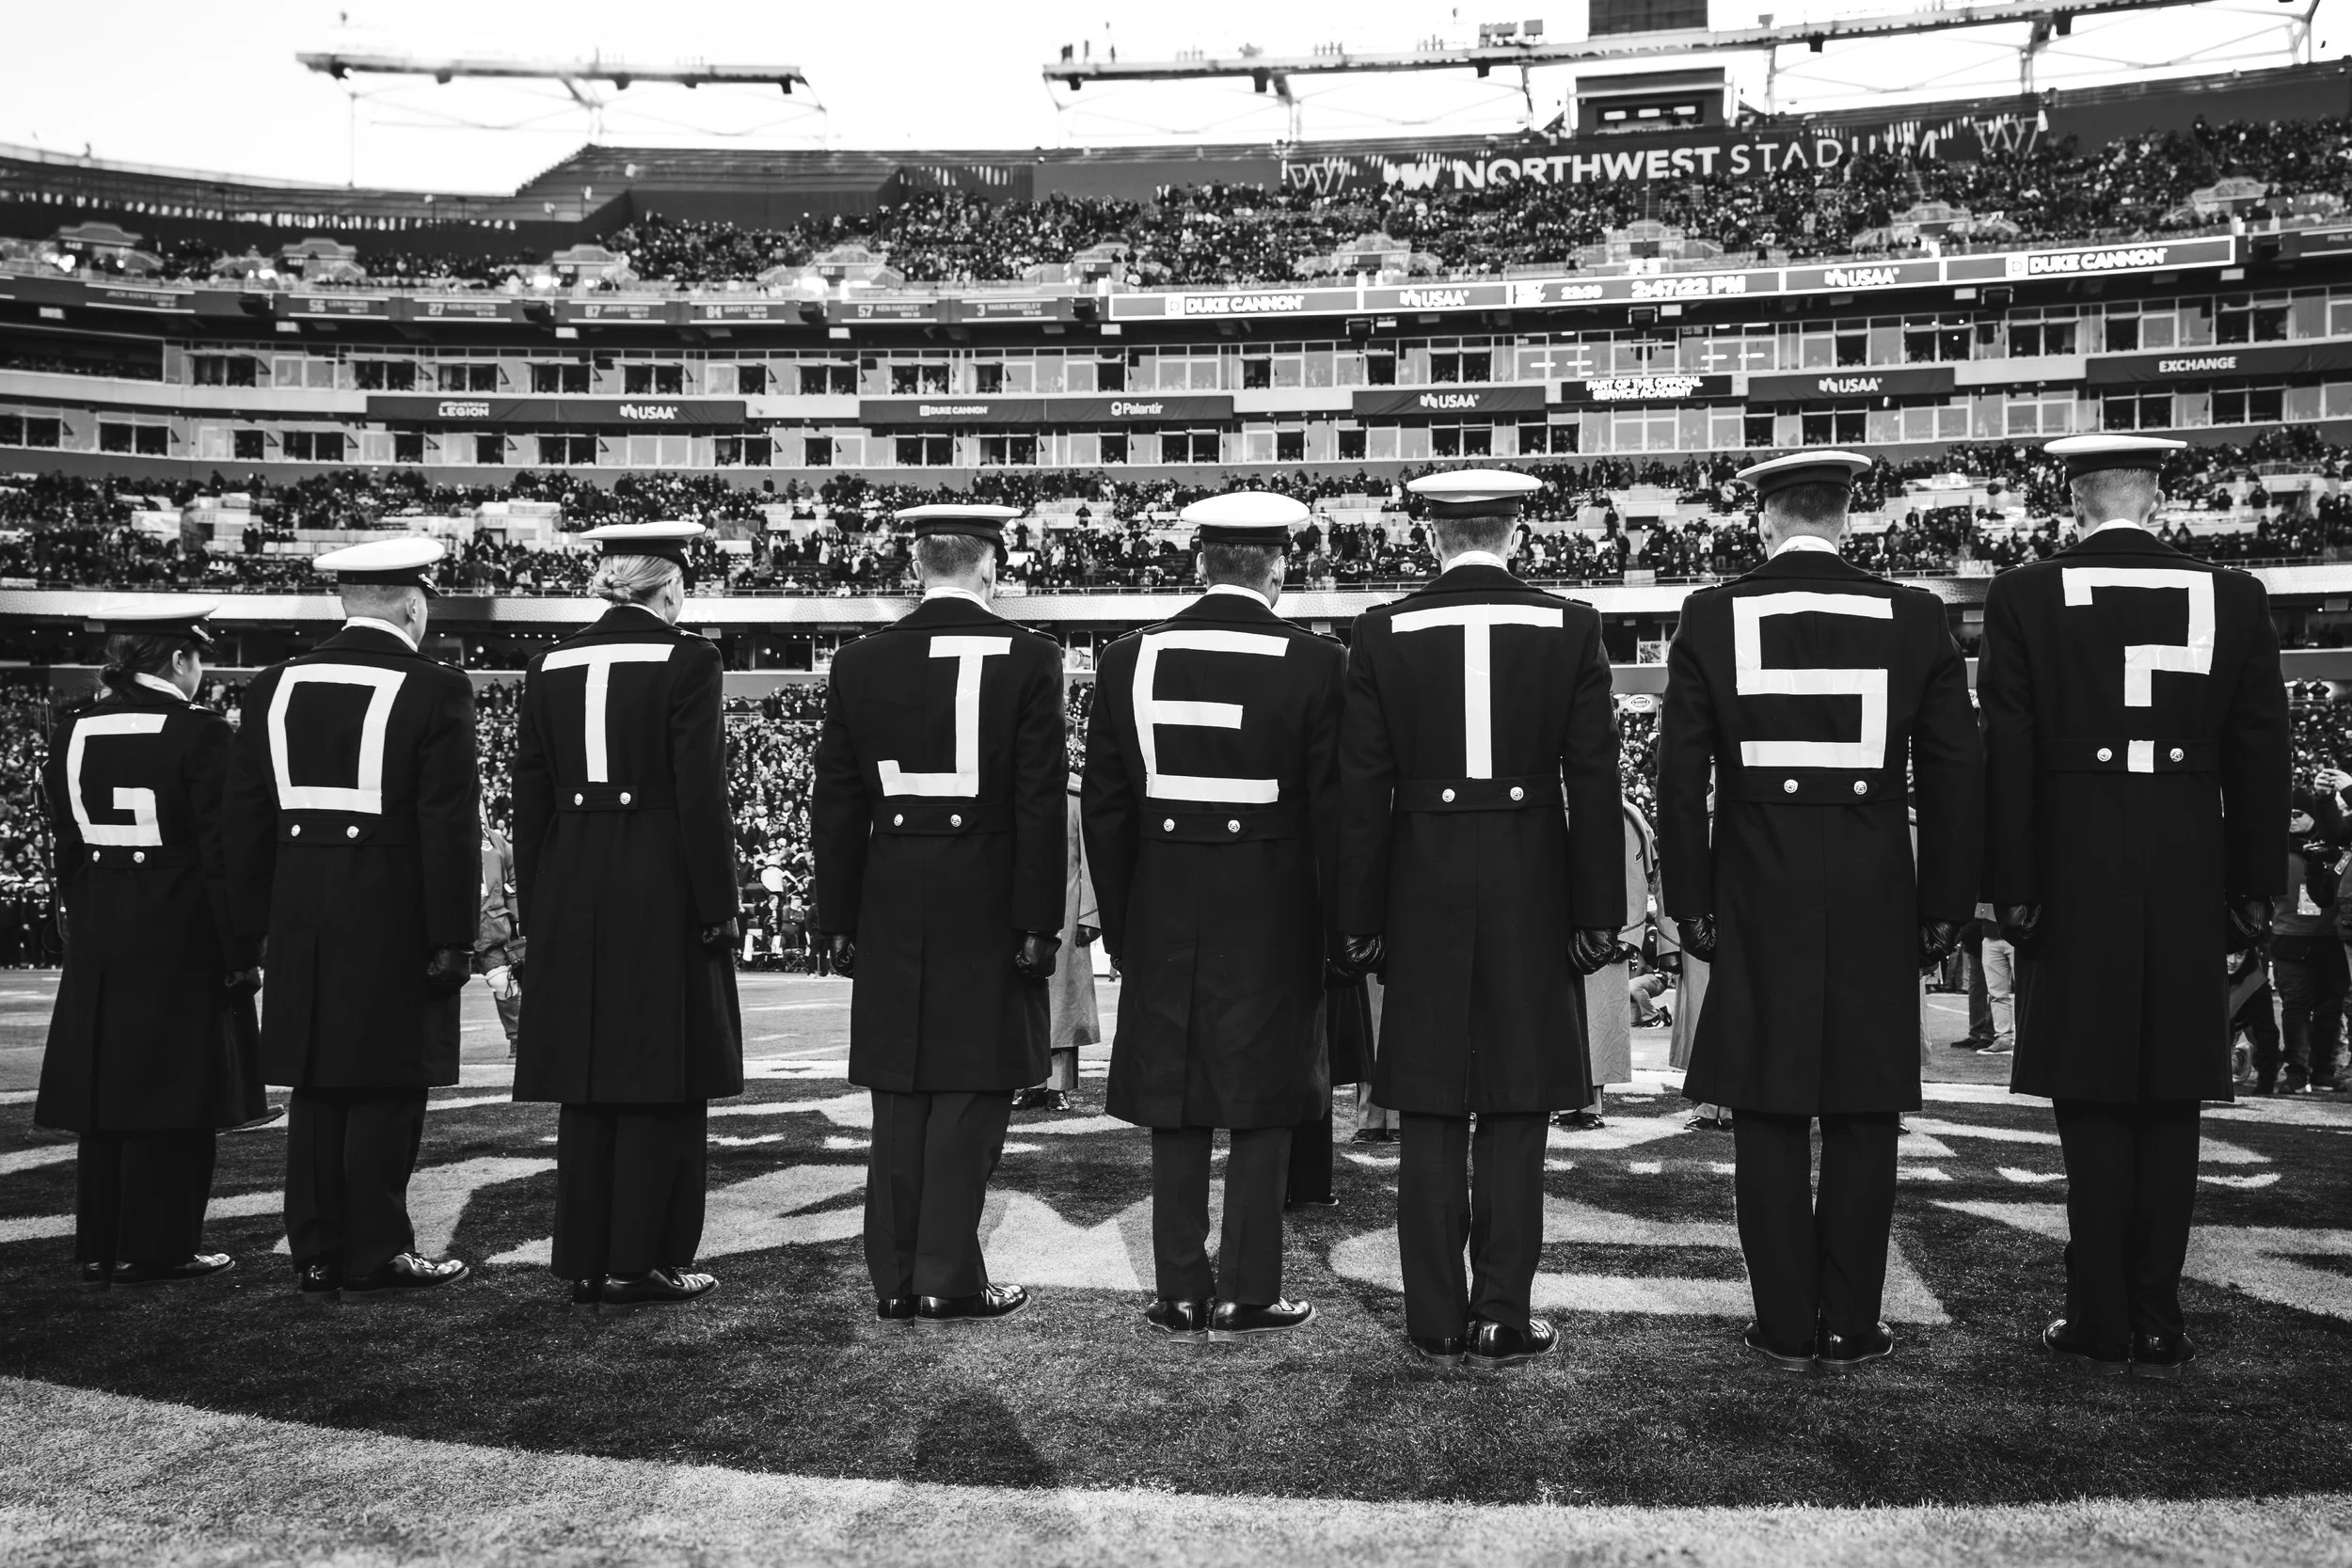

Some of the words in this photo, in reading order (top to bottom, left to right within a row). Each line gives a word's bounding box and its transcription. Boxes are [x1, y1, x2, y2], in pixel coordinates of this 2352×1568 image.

[1454, 146, 1721, 189] NORTHWEST
[2029, 253, 2080, 275] DUKE
[2081, 248, 2165, 271] CANNON
[1848, 269, 1895, 286] USAA
[1711, 276, 1747, 295] PM
[1185, 296, 1230, 313] DUKE
[1230, 295, 1302, 312] CANNON
[1422, 290, 1465, 307] USAA
[858, 305, 874, 318] 57
[977, 304, 986, 317] 3
[2158, 356, 2237, 372] EXCHANGE
[1586, 379, 1614, 391] PART
[1614, 379, 1630, 390] OF
[1631, 378, 1653, 389] THE
[1654, 376, 1704, 388] OFFICIAL
[1838, 378, 1878, 393] USAA
[1438, 394, 1476, 408] USAA
[1593, 388, 1639, 401] SERVICE
[1640, 386, 1693, 399] ACADEMY
[437, 406, 489, 417] LEGION
[638, 406, 675, 420] USAA
[930, 405, 951, 416] DUKE
[952, 405, 988, 416] CANNON
[1122, 403, 1163, 416] Palantir
